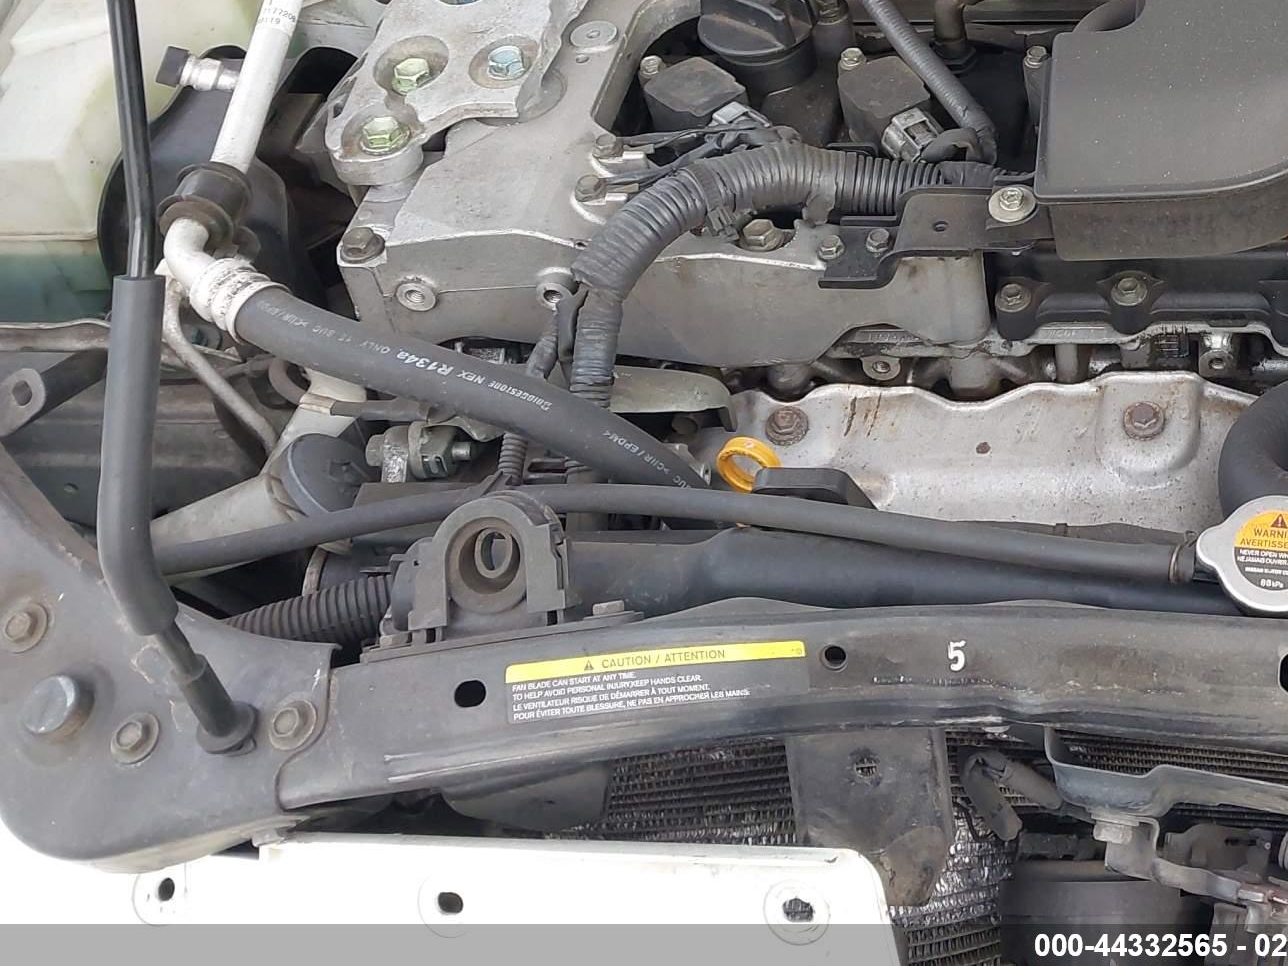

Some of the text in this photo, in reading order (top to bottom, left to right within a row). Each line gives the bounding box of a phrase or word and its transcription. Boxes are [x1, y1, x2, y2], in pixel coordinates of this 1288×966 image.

[456, 369, 487, 386] NEX
[1260, 550, 1278, 558] OPEN
[601, 654, 651, 669] CAUTION
[664, 649, 726, 663] ATTENTION
[948, 640, 966, 671] 5
[512, 684, 526, 693] FAN
[528, 680, 551, 690] BLADE
[552, 679, 568, 688] CAN
[569, 675, 591, 686] START
[592, 675, 601, 683] AT
[602, 673, 617, 682] ANY
[524, 691, 543, 699] HELP
[544, 688, 565, 697] AVOID
[567, 684, 605, 694] PERSONAL
[650, 676, 676, 685] HANDS
[513, 703, 523, 711] LE
[523, 698, 570, 710] VENTILATEUR
[570, 694, 597, 704] RISQUE
[600, 693, 609, 701] DE
[610, 688, 650, 700] DÉMARRER
[657, 686, 677, 694] TOUT
[513, 711, 535, 720] POUR
[536, 707, 560, 718] ÉVITER
[562, 705, 585, 714] TOUTE
[586, 699, 626, 712] BLESSURE,
[626, 699, 636, 707] NE
[638, 697, 653, 706] PAS
[653, 696, 664, 704] EN
[665, 691, 710, 703] APPROCHER
[710, 690, 724, 699] LES
